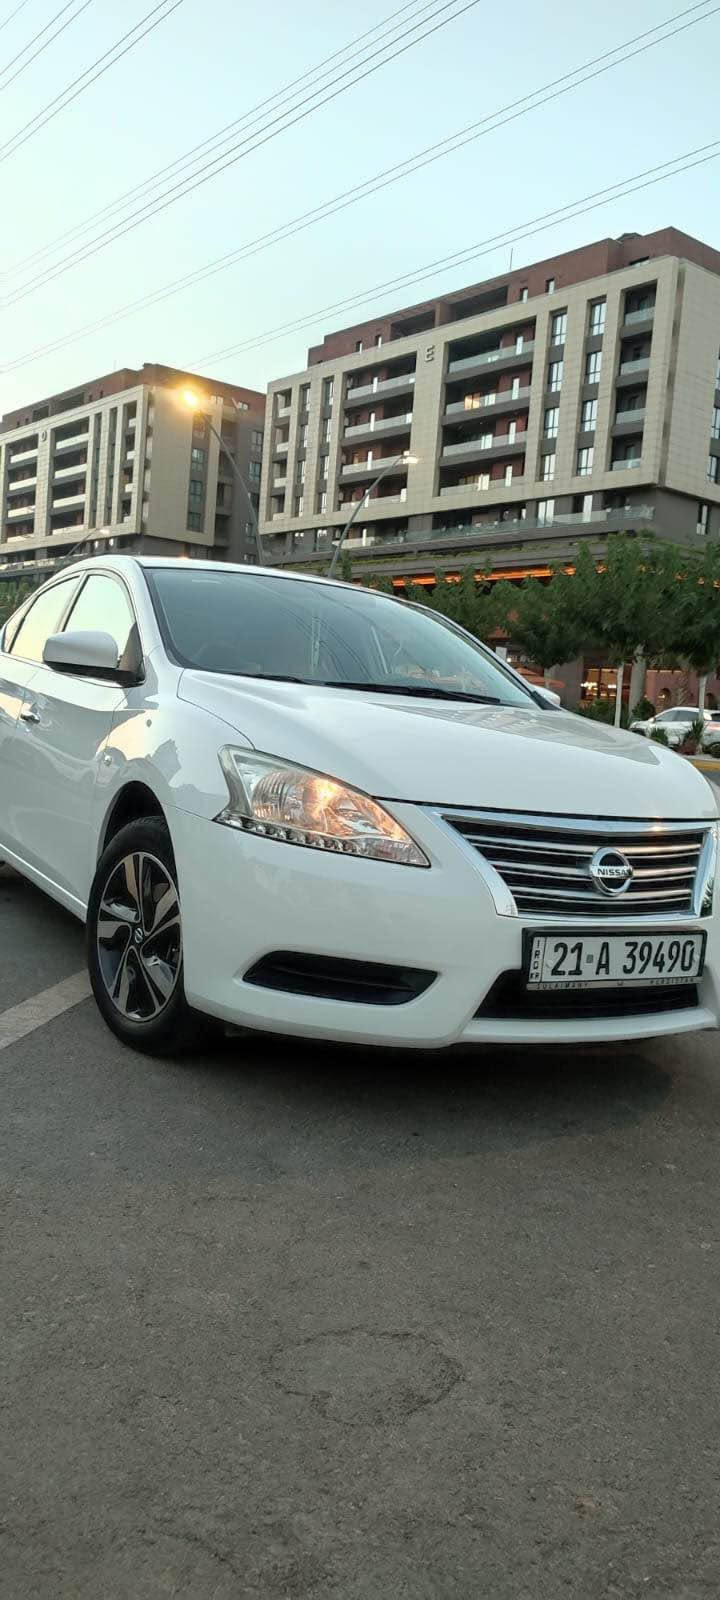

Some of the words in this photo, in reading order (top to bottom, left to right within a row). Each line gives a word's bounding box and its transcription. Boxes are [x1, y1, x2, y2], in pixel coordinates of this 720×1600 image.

[426, 344, 435, 362] E
[597, 868, 631, 876] NISSA
[551, 942, 583, 976] 21
[595, 942, 609, 976] A
[622, 940, 695, 974] 39490
